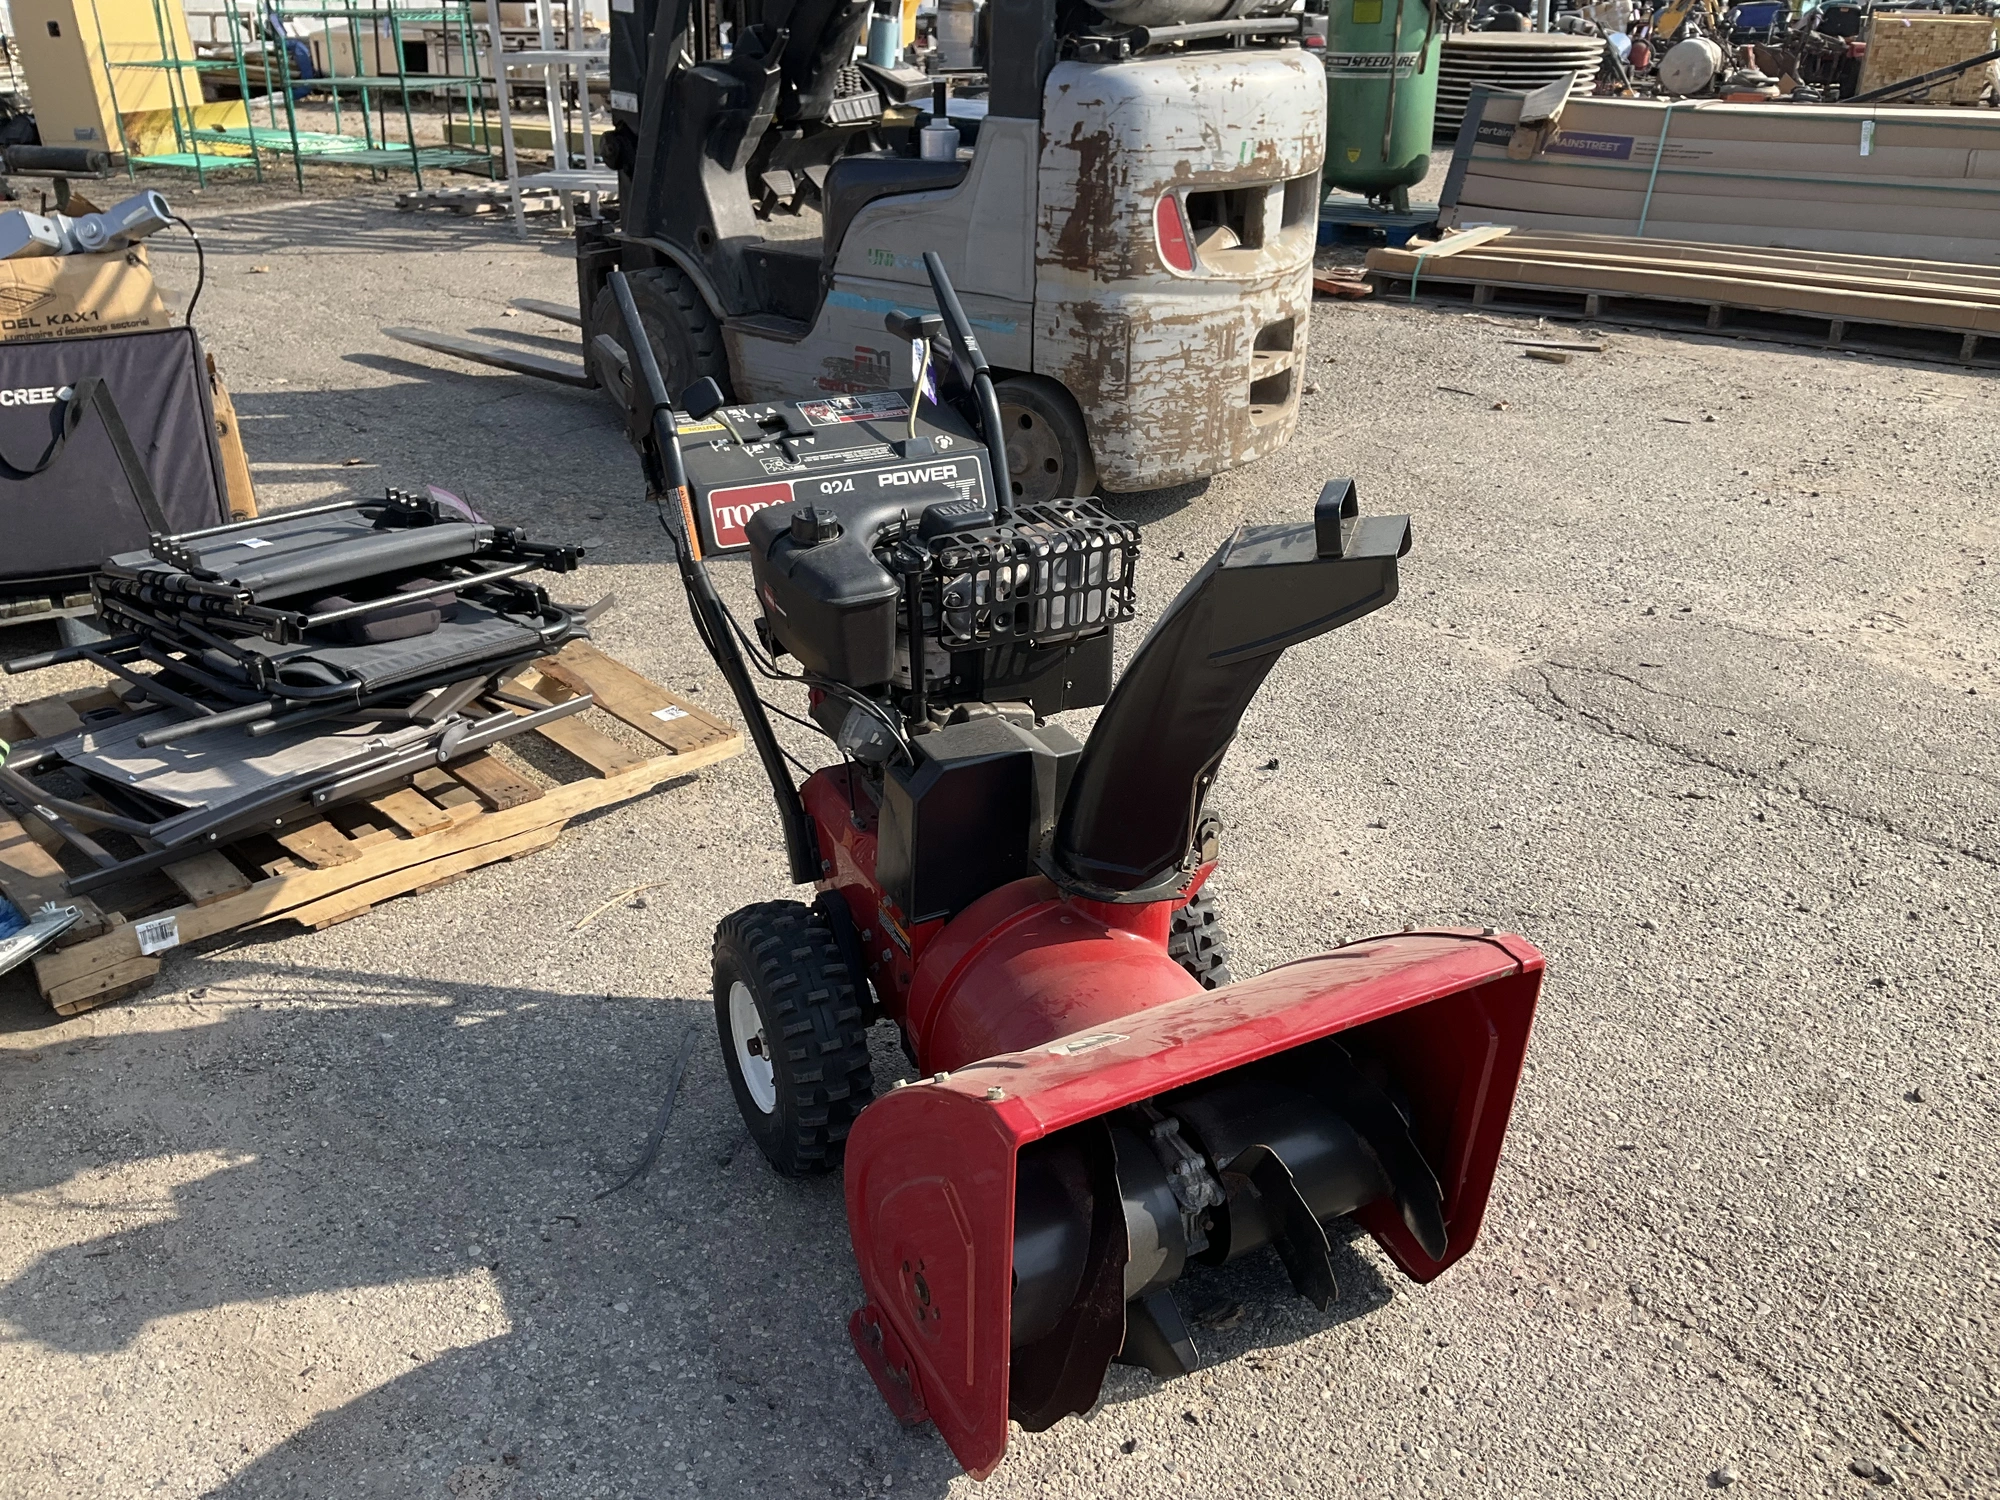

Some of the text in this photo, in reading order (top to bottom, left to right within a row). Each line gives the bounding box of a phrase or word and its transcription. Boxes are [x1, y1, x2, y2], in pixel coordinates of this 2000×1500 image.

[2, 317, 41, 330] DEL
[0, 386, 57, 407] CREE
[878, 464, 958, 487] POWER
[820, 478, 856, 495] 924
[716, 499, 786, 530] TO
